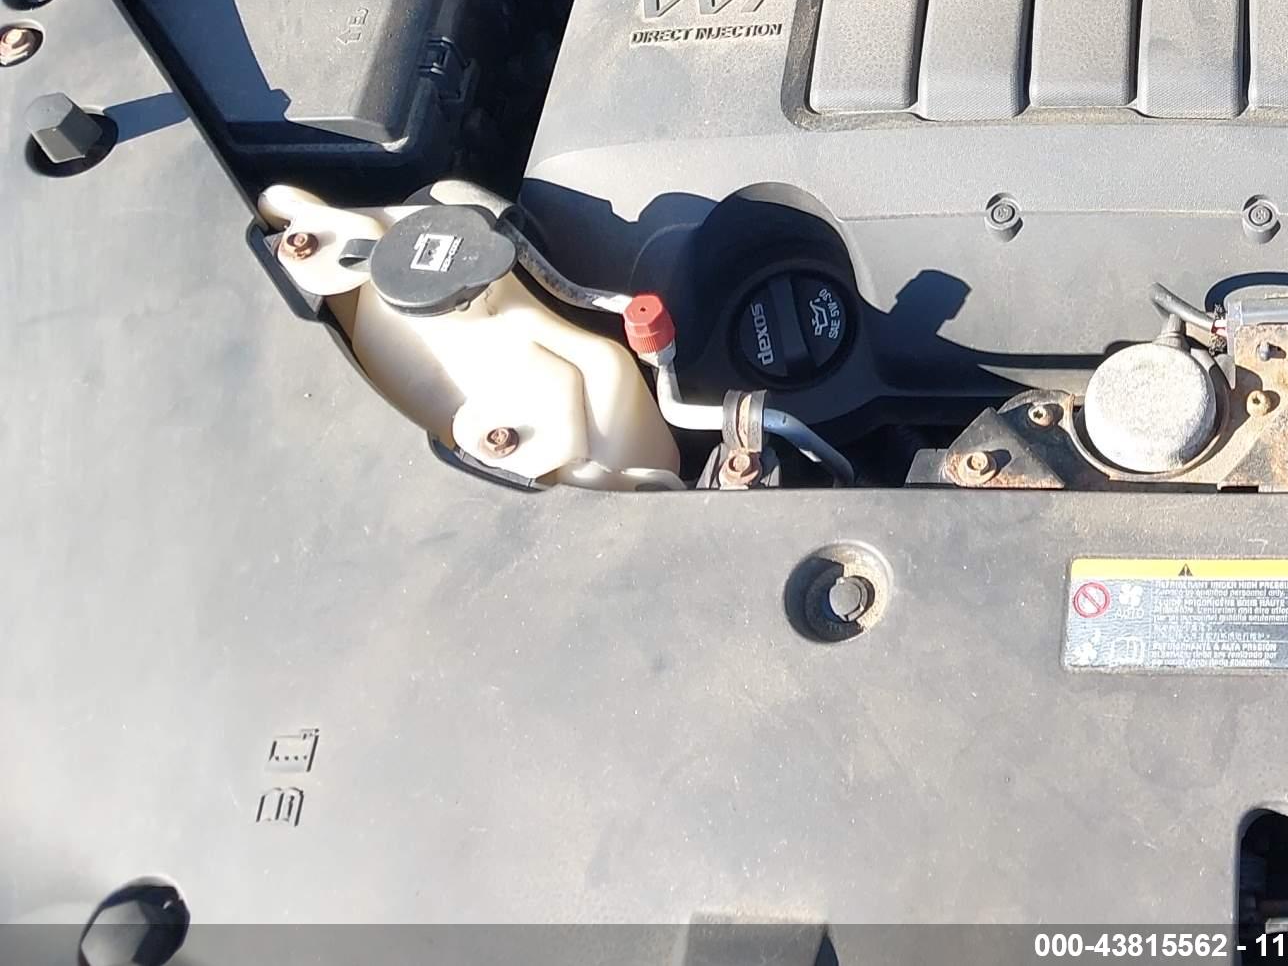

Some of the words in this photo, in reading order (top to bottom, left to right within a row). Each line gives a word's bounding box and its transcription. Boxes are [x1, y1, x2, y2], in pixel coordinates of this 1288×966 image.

[631, 28, 693, 44] DIRECT
[695, 23, 783, 40] INJECTION
[750, 302, 774, 366] dexos
[828, 319, 841, 339] SAE
